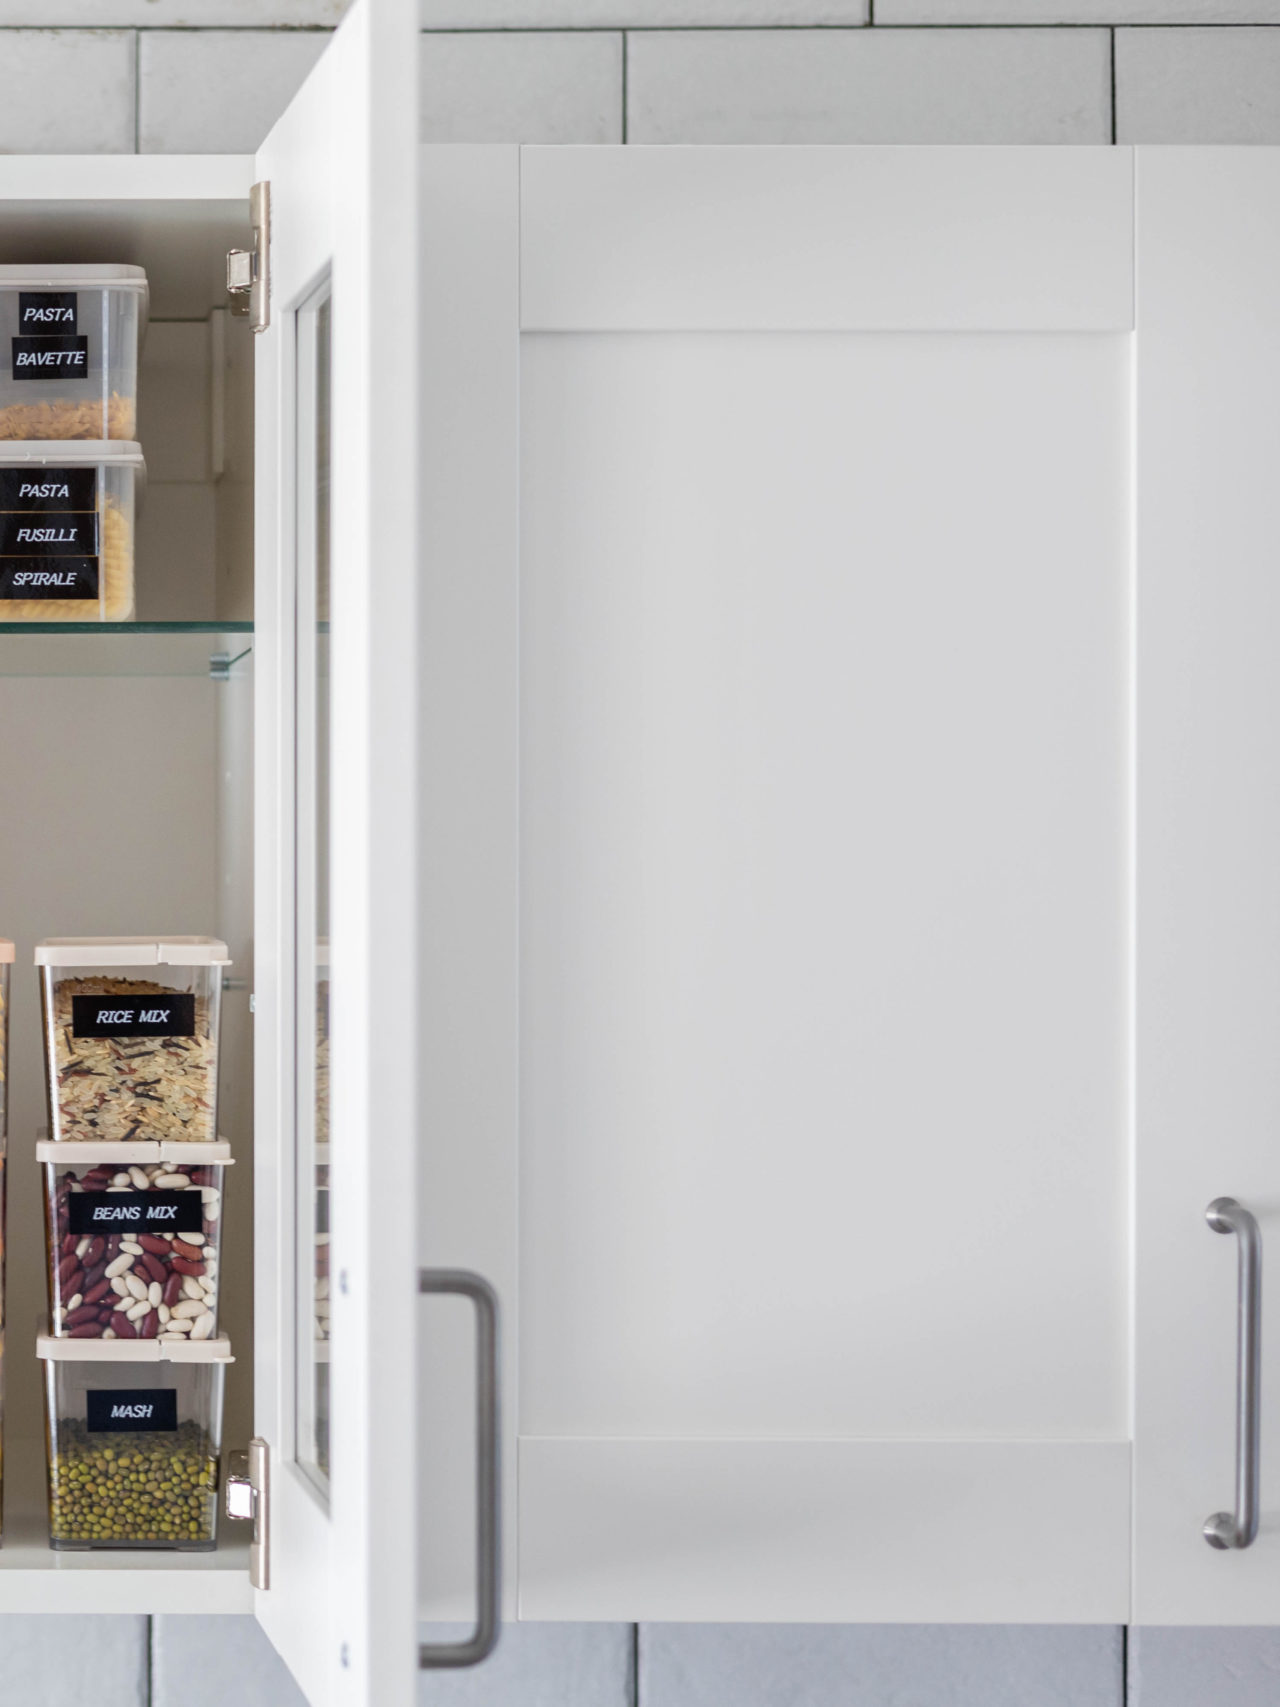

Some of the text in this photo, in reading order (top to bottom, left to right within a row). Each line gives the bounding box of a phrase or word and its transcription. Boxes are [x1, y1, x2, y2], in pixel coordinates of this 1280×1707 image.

[23, 307, 74, 322] PASTA
[16, 351, 86, 366] BAVETTE
[18, 483, 69, 498] PASTA
[16, 528, 78, 542] FUSILLI
[12, 572, 78, 586] SPIRALE
[96, 1009, 171, 1024] RICE MIX
[92, 1205, 178, 1220] BEANS MIX
[110, 1404, 153, 1418] MASH
